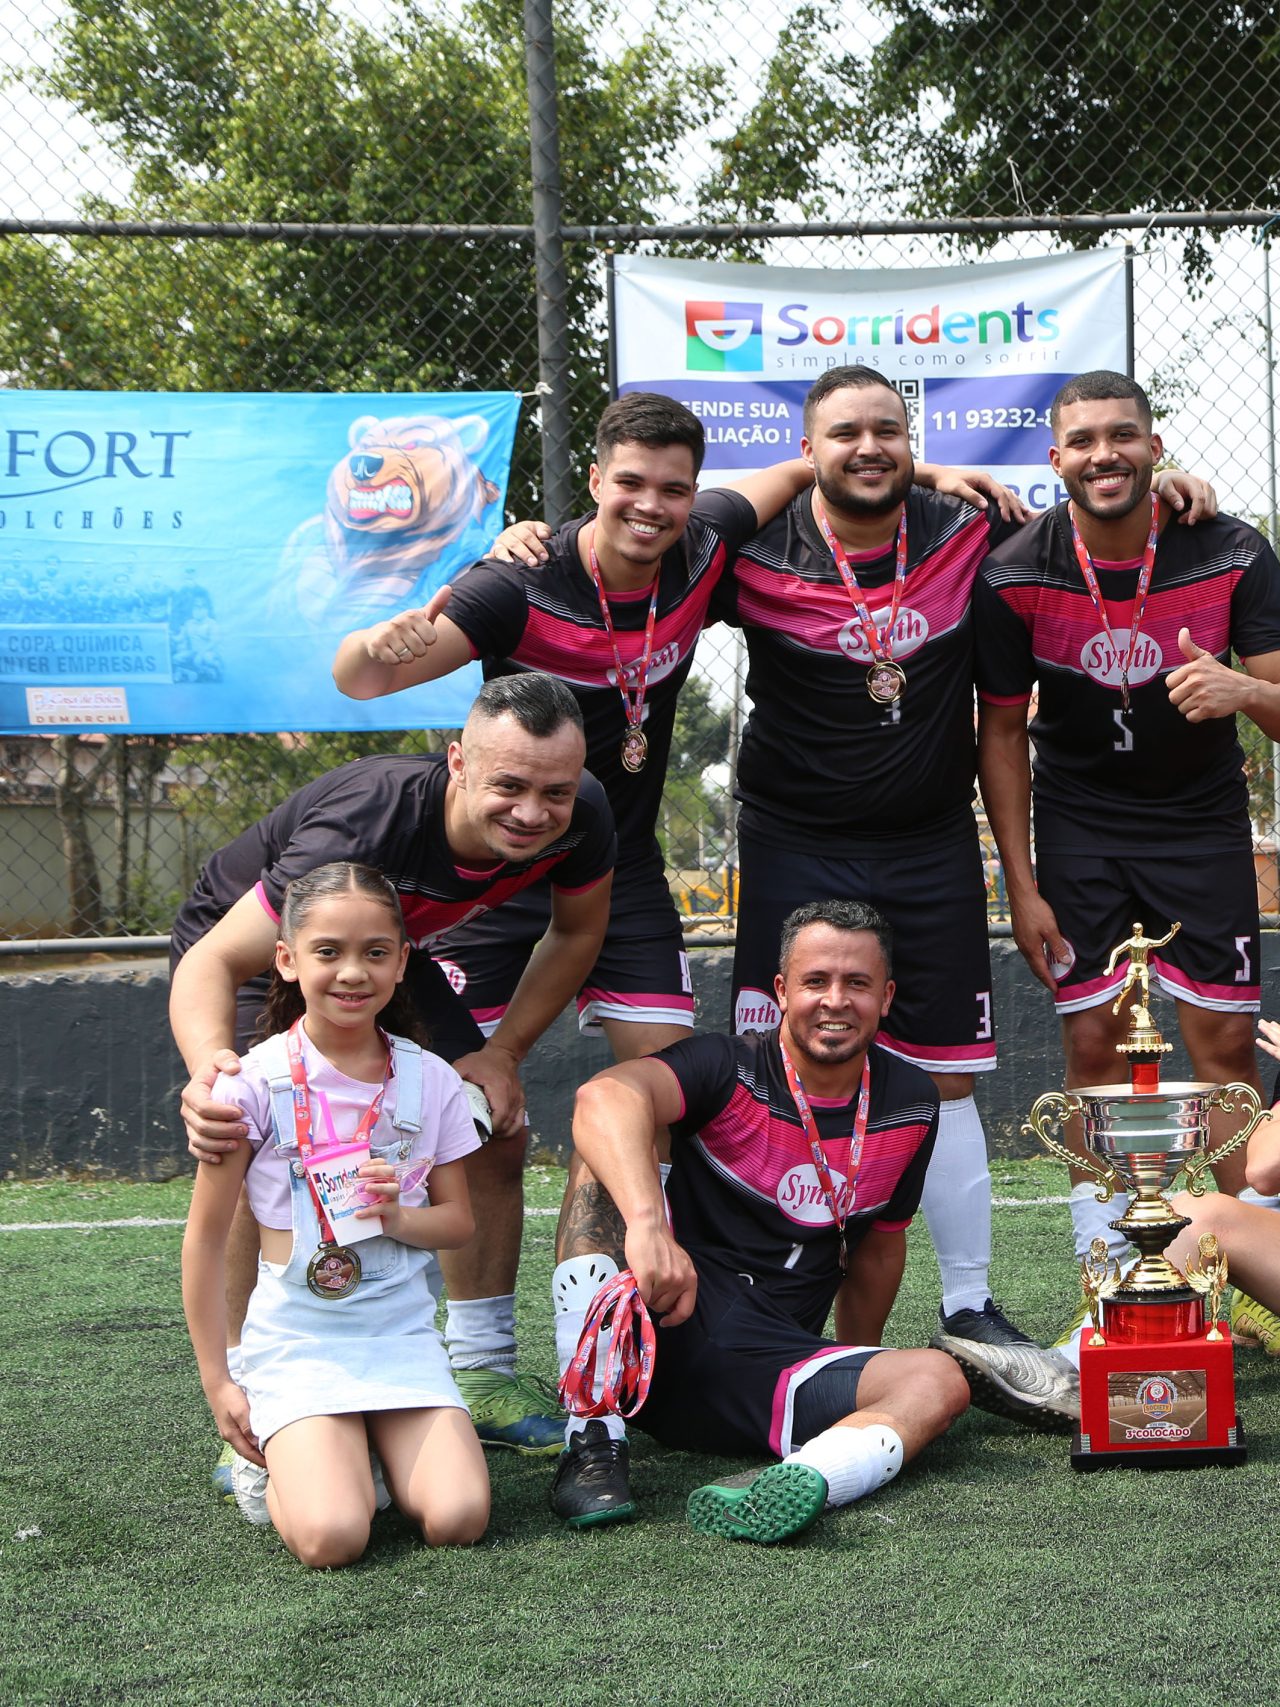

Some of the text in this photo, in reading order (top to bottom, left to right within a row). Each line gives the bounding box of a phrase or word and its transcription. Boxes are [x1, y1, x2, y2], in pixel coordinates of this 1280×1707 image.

[777, 348, 1061, 371] simples como sorrir
[749, 403, 790, 418] SUA
[932, 411, 957, 430] 11
[704, 424, 780, 447] LIAÇÃO
[5, 430, 192, 478] FORT
[8, 635, 55, 652] COPA
[57, 655, 157, 673] EMPRESAS
[36, 715, 125, 724] DEMARCHI
[1113, 708, 1133, 751] 5
[1235, 936, 1251, 982] 5
[975, 991, 993, 1040] 3
